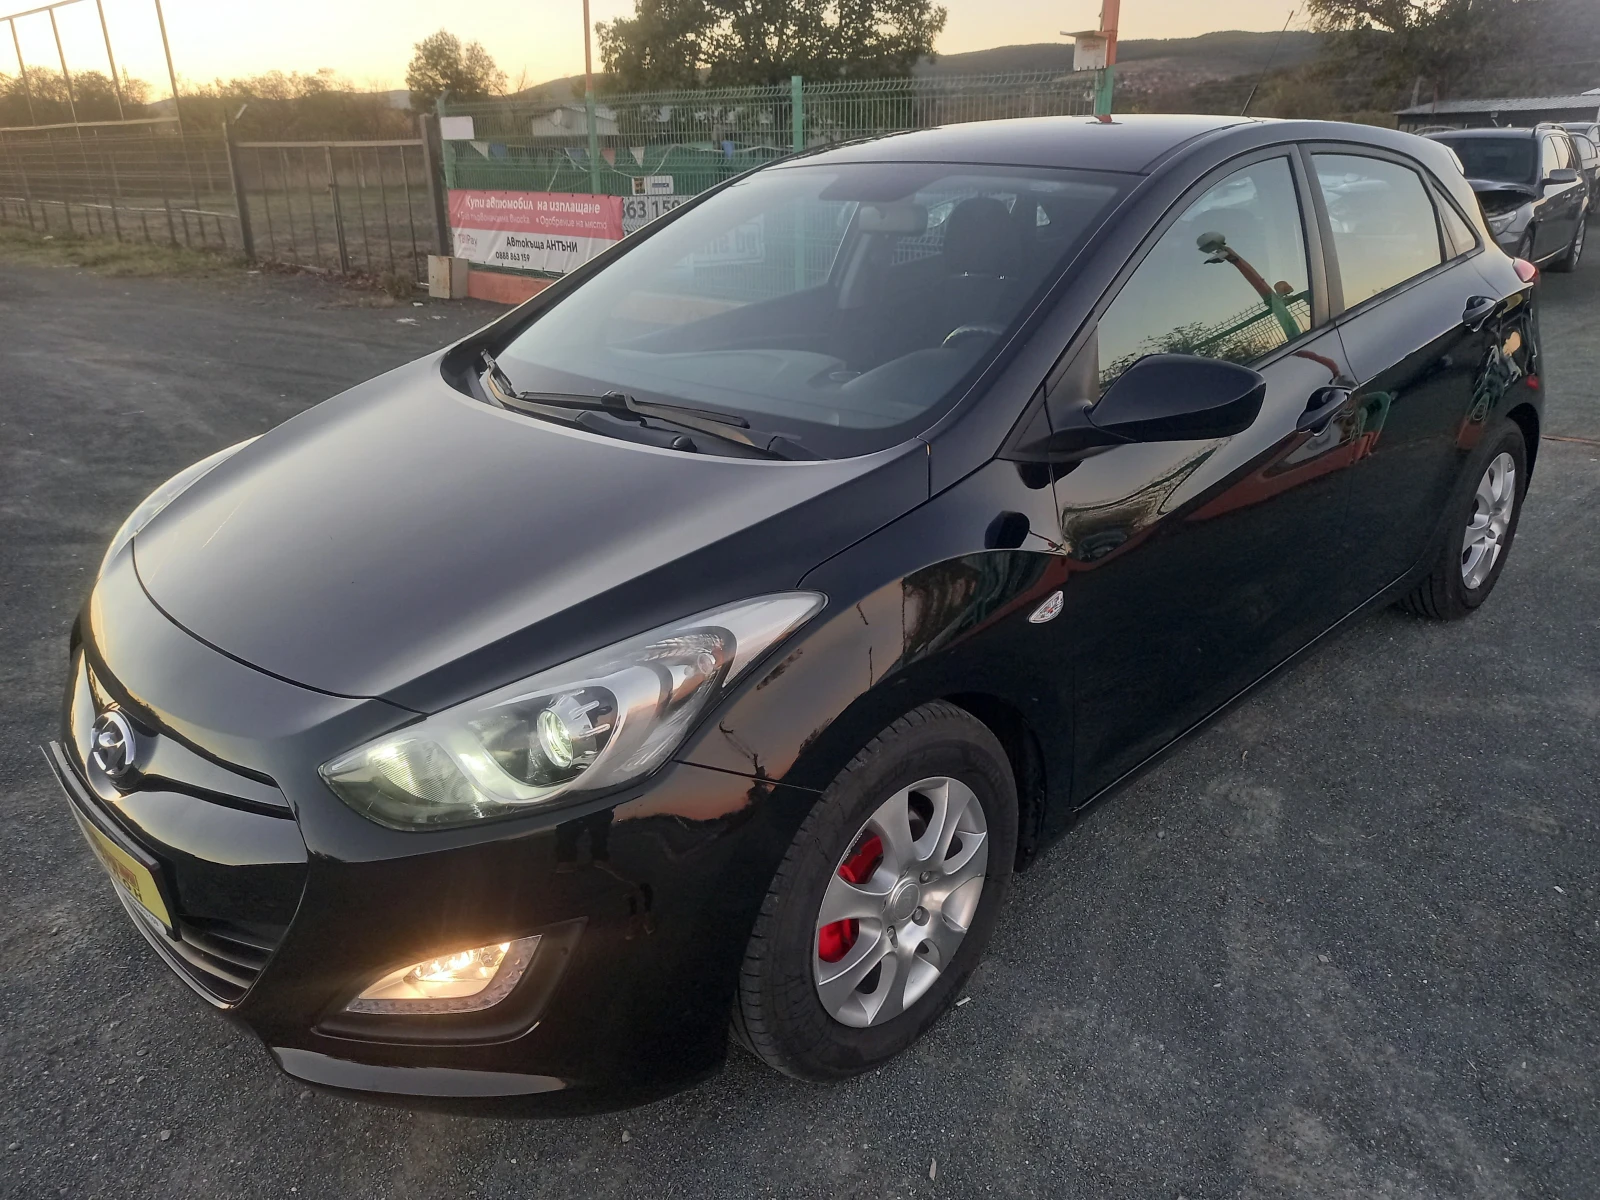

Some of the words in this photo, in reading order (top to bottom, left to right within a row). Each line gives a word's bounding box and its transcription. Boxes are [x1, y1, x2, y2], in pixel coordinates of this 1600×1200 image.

[466, 195, 485, 209] Купи
[486, 196, 533, 210] автомобил
[537, 200, 547, 210] на
[550, 202, 600, 215] изплащане
[576, 219, 584, 228] на
[507, 236, 545, 251] Автокъща
[546, 239, 578, 253] АНТЪНИ
[495, 251, 509, 260] 0888
[510, 252, 520, 261] 863
[521, 253, 530, 262] 159
